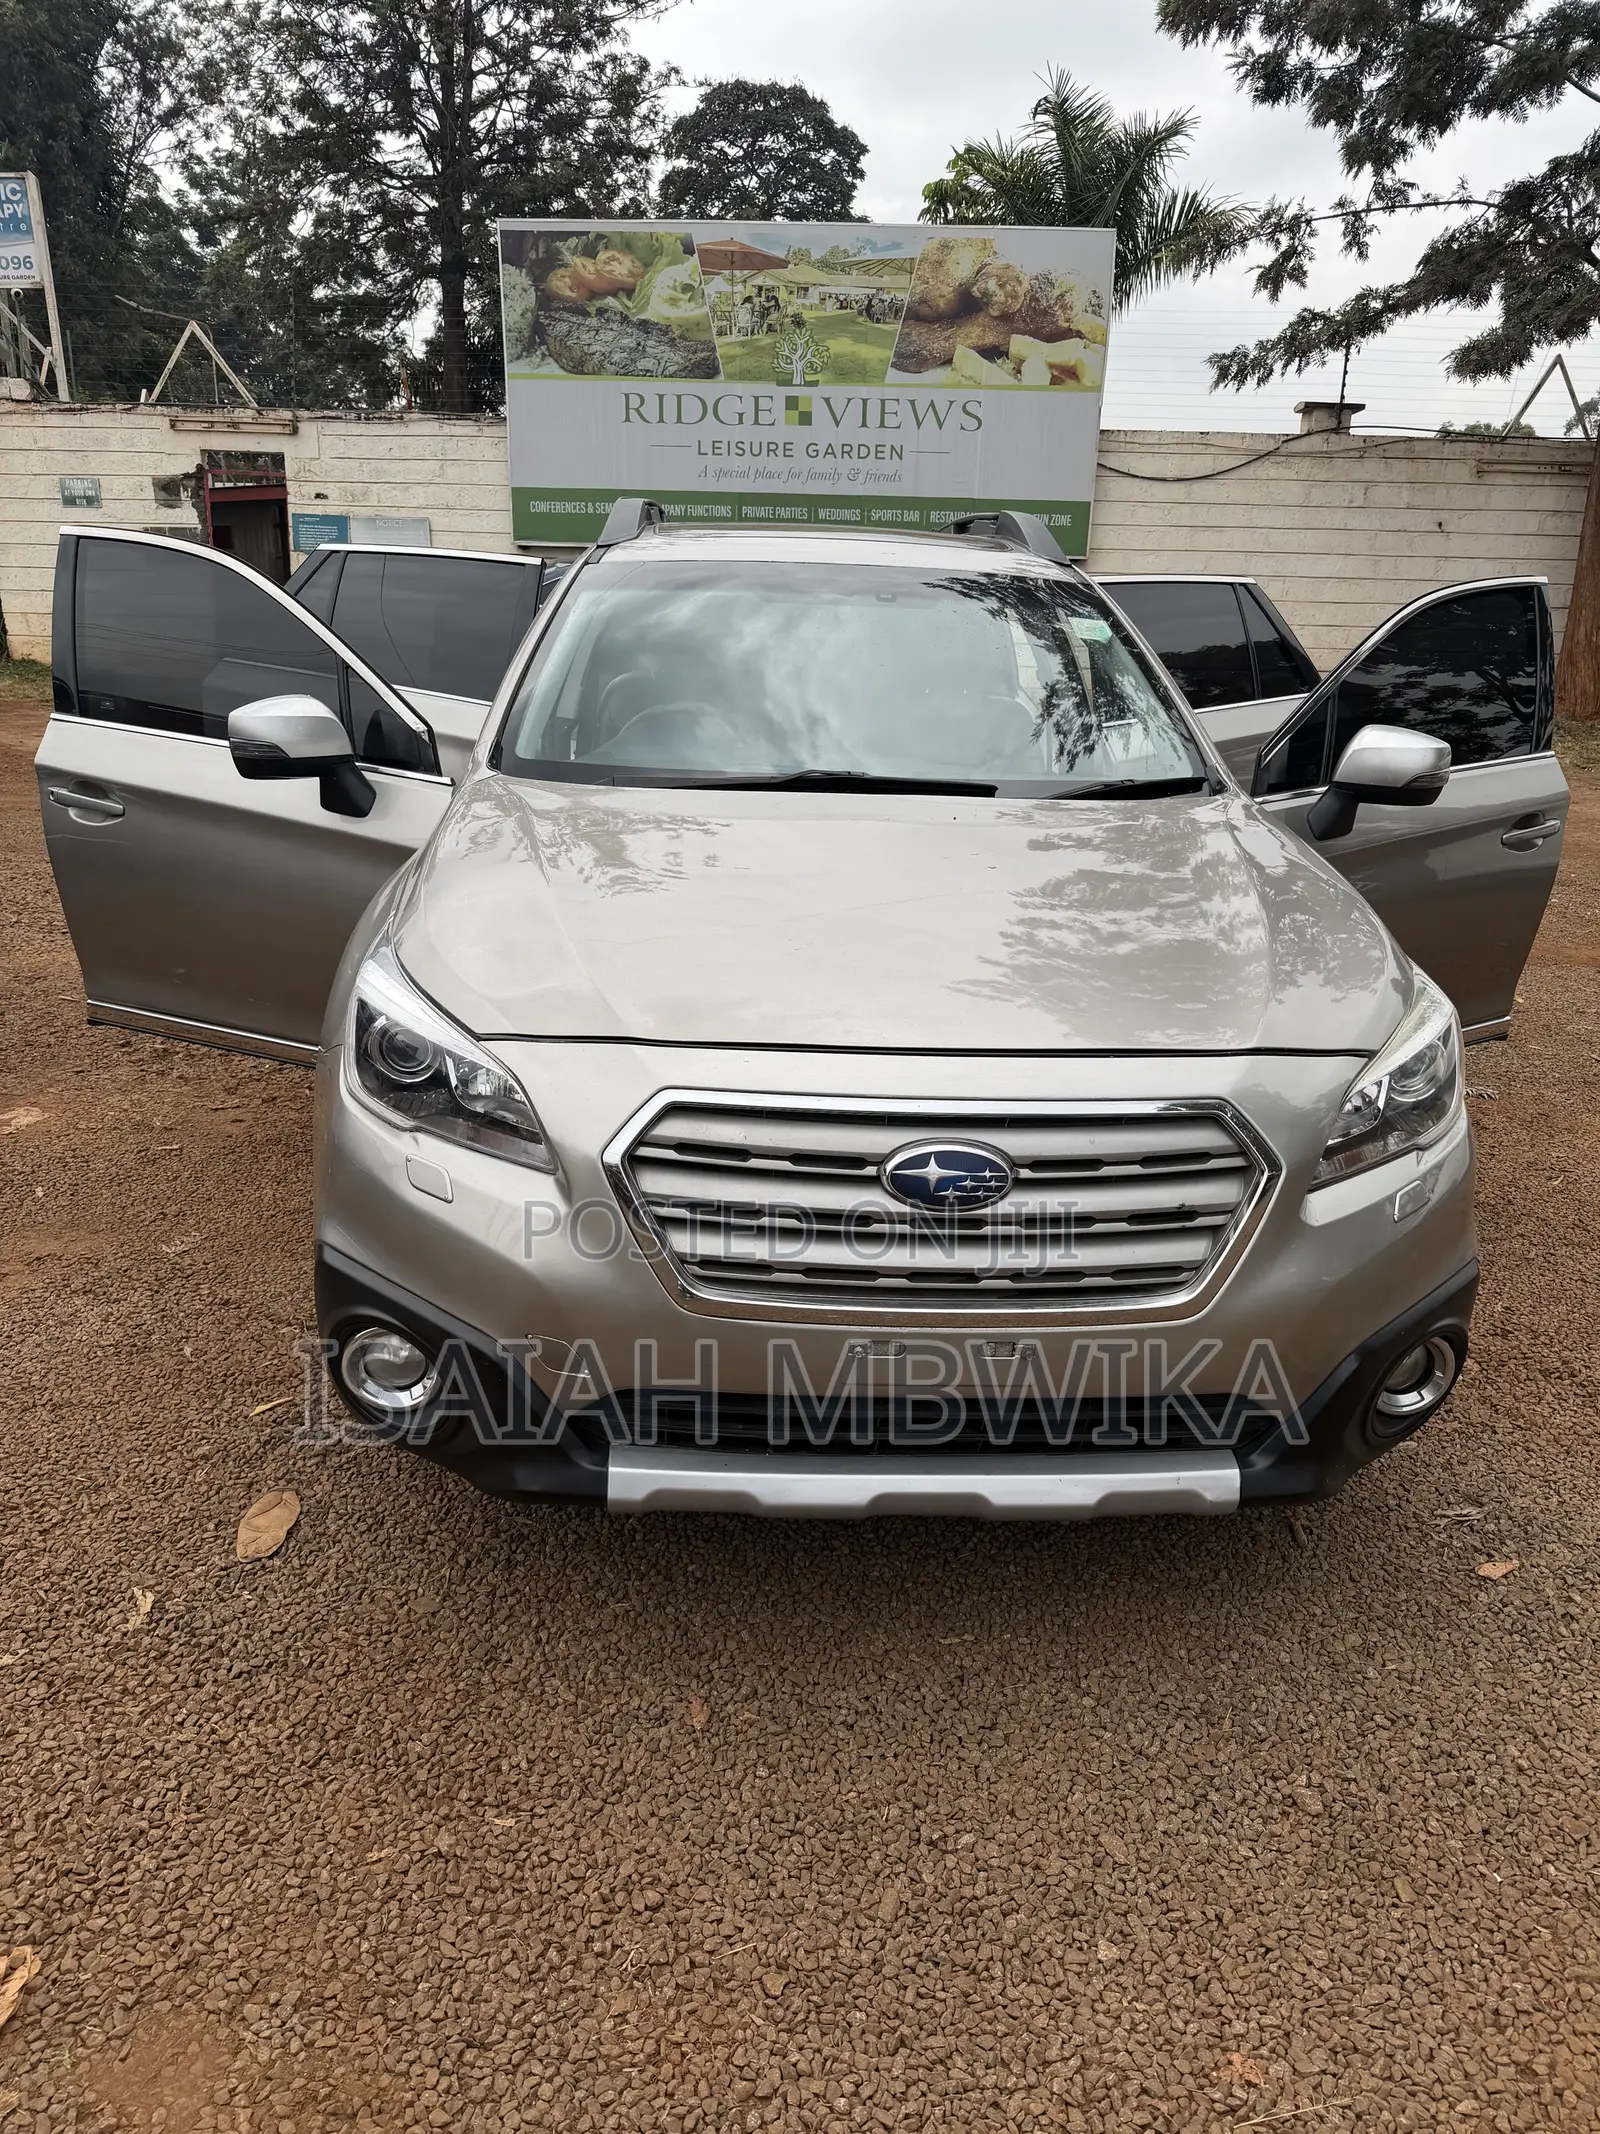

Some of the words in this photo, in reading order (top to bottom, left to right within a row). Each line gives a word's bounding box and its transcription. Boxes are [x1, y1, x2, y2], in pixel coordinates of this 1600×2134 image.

[620, 392, 777, 426] RIDGE
[820, 396, 983, 432] VIEWS
[697, 439, 795, 458] LEISURE
[805, 442, 904, 461] GARDEN
[698, 464, 708, 478] A
[712, 465, 751, 482] special
[752, 465, 784, 484] place
[783, 466, 803, 484] for
[801, 467, 842, 486] family
[847, 468, 861, 482] &
[860, 468, 903, 486] friends
[65, 478, 93, 488] PARKING
[530, 501, 586, 514] CONFERENCES
[587, 502, 594, 514] &
[687, 504, 732, 518] FUNCTIONS
[742, 506, 775, 519] PRIVATE
[775, 507, 808, 520] PARTIES
[818, 508, 861, 521] WEDDINGS
[376, 519, 404, 527] NOTICE
[870, 509, 902, 522] SPORTS
[903, 511, 920, 523] BAR
[1050, 514, 1072, 526] ZONE
